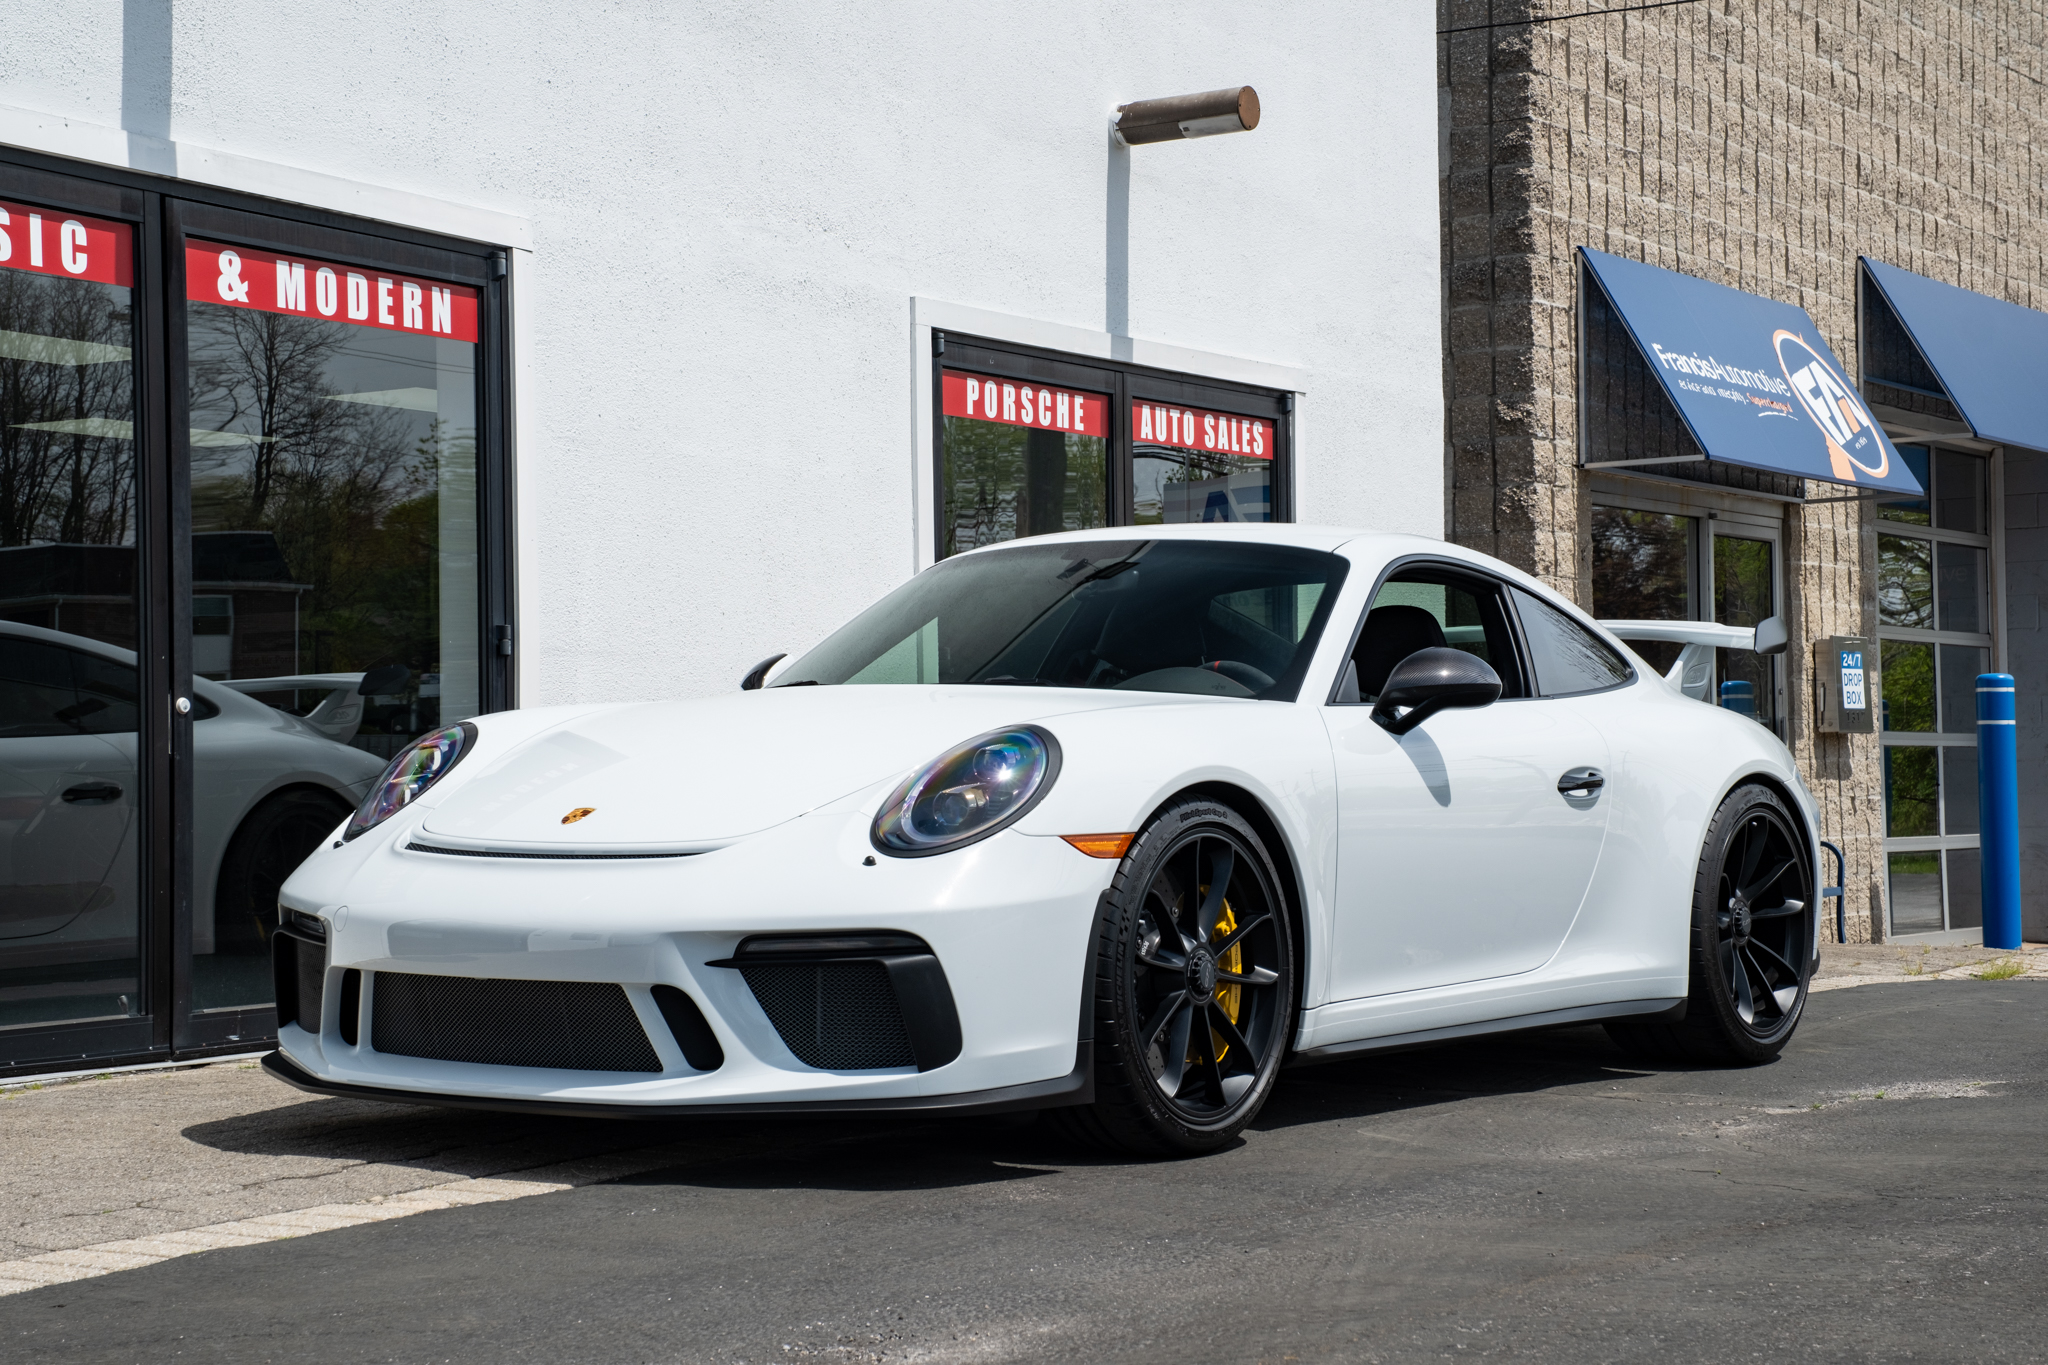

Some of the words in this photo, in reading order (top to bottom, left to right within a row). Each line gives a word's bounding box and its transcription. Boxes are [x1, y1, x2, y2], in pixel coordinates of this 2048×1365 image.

[217, 250, 249, 303] &
[276, 259, 453, 334] MODERN
[966, 377, 1085, 432] PORSCHE
[1140, 404, 1195, 446] AUTO
[1204, 413, 1265, 456] SALES
[1842, 653, 1861, 667] 24/7
[1843, 673, 1862, 686] DROP
[1846, 691, 1862, 704] BOX
[1115, 942, 1125, 1015] MICHELIN
